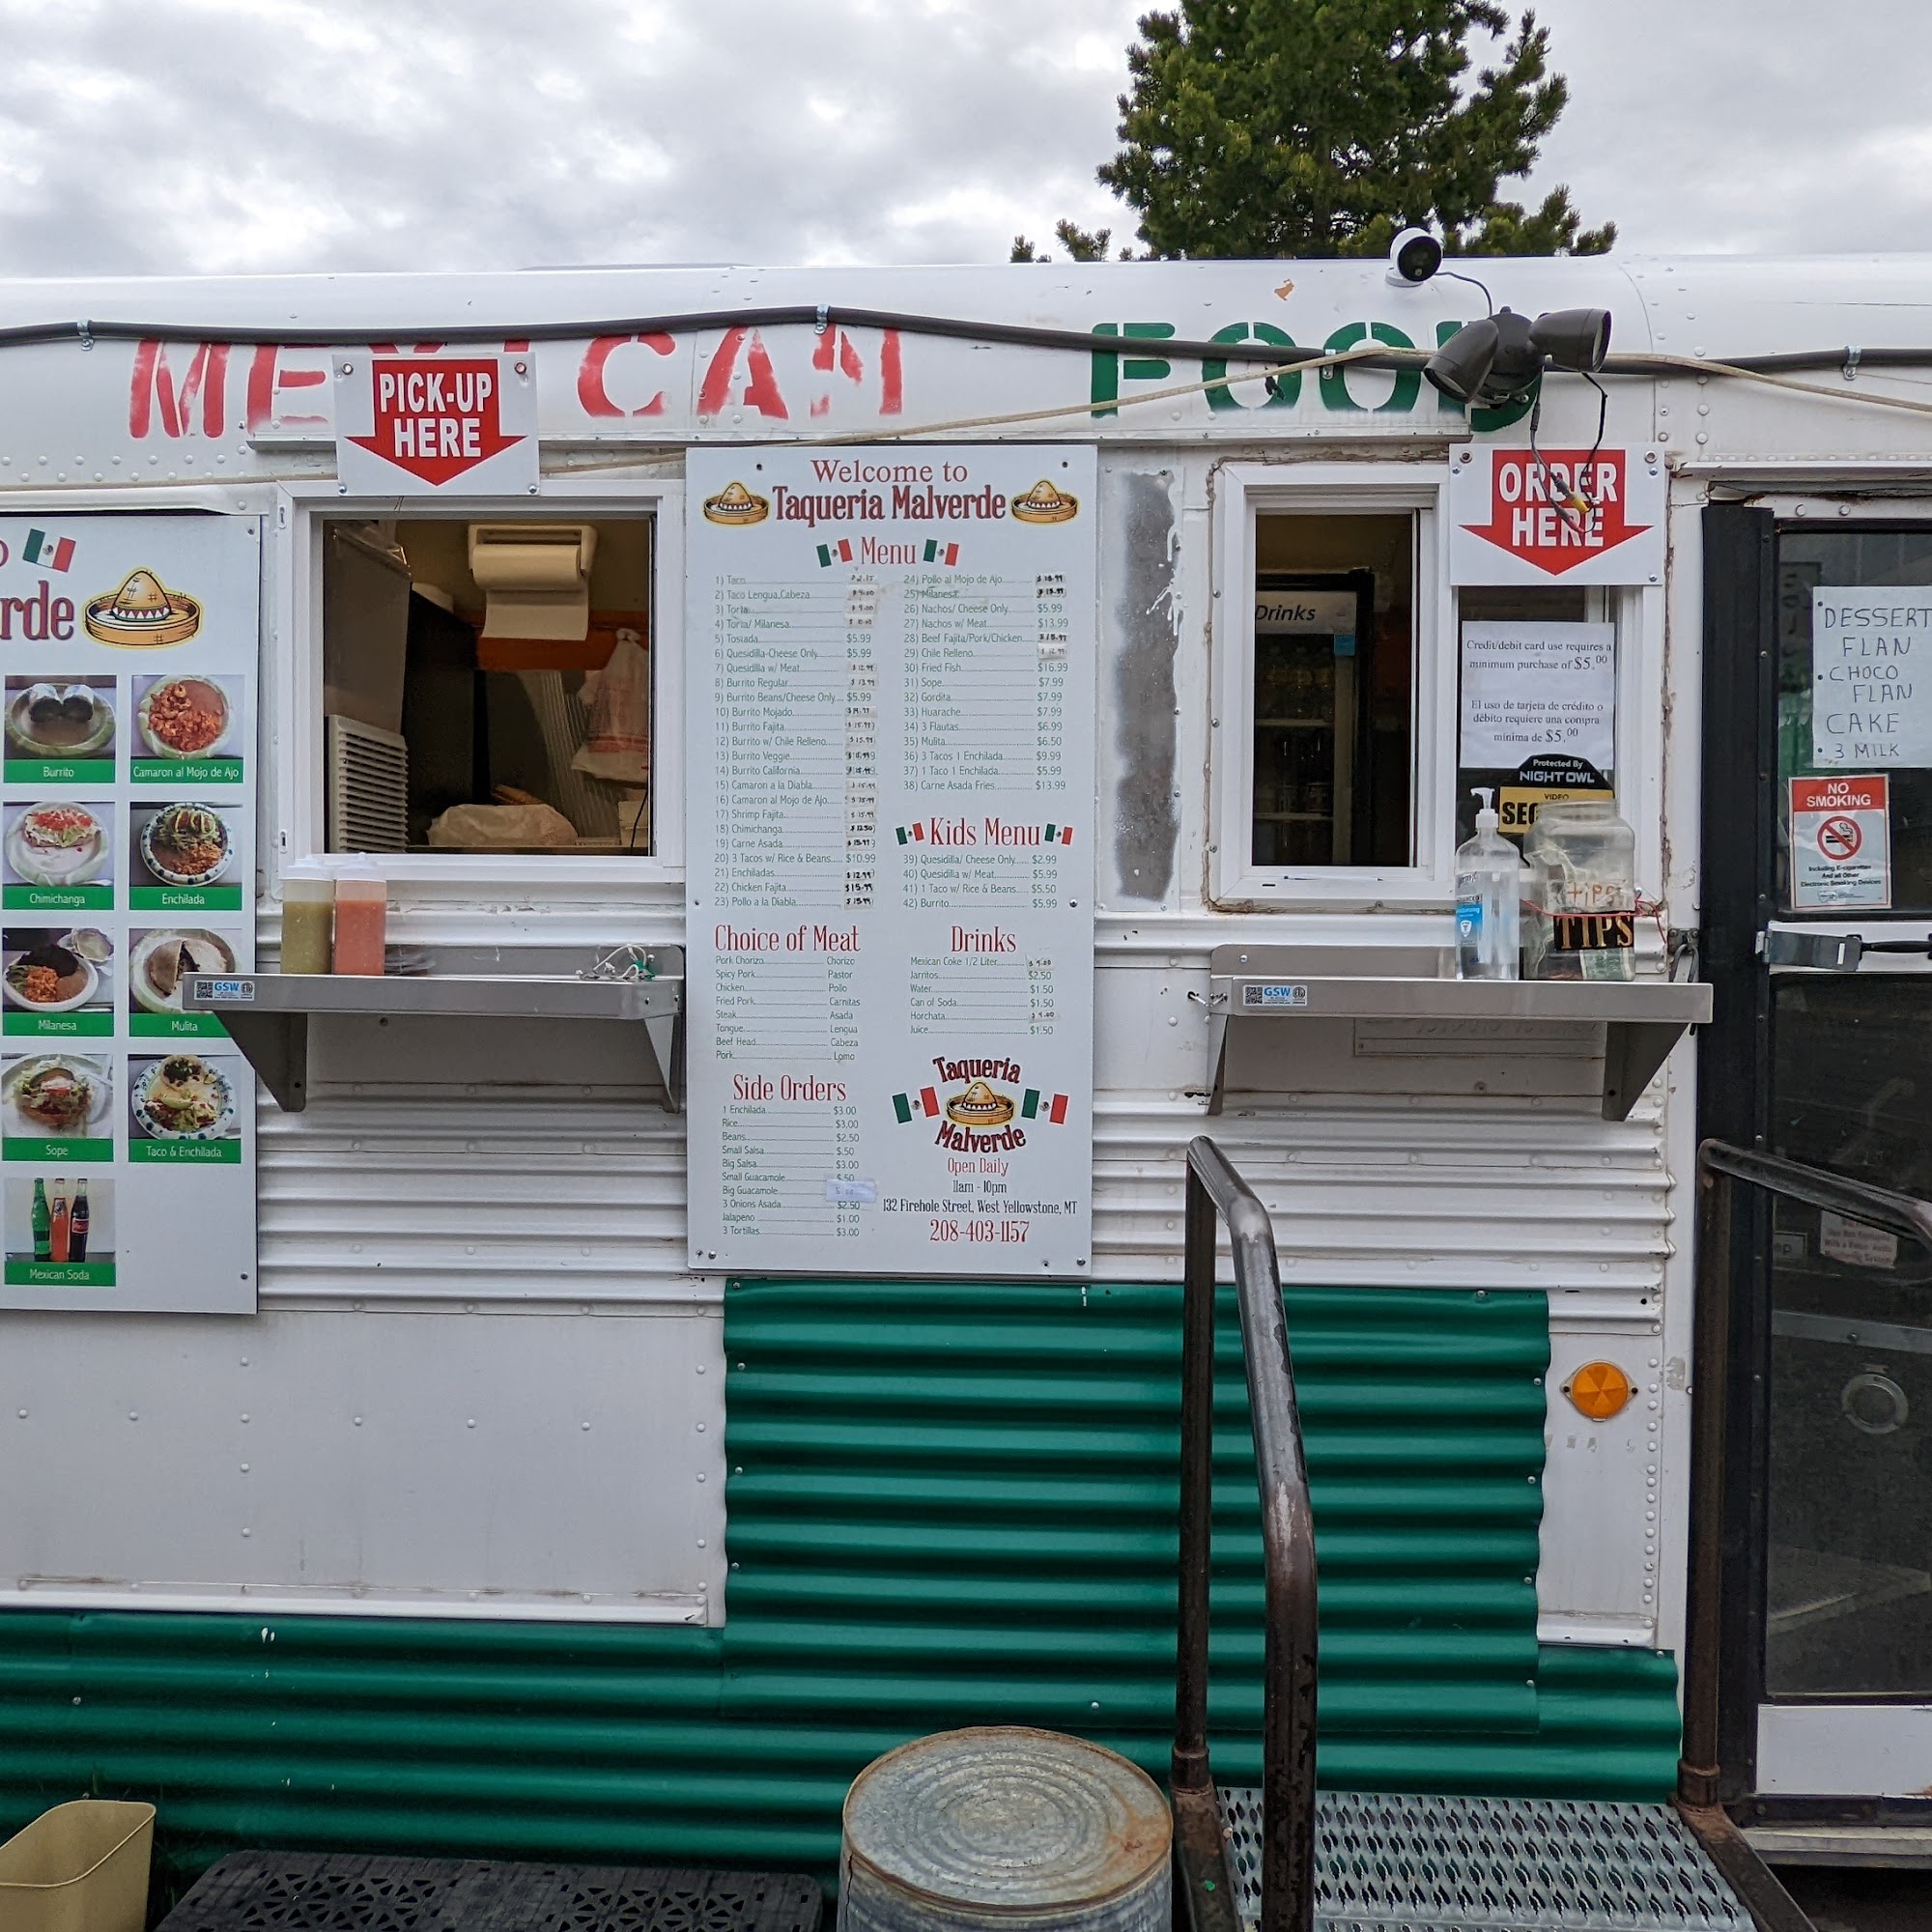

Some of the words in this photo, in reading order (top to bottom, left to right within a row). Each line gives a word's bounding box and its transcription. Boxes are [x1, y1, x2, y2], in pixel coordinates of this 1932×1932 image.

[128, 325, 903, 440] MECAN
[381, 373, 492, 412] PICK-UP
[394, 418, 481, 458] HERE
[810, 460, 934, 482] Welcome
[943, 461, 968, 482] to
[1499, 463, 1617, 501] ORDER
[773, 485, 885, 527] Taqueria
[892, 485, 1006, 521] Malverde
[1513, 508, 1603, 546] HERE
[861, 536, 916, 564] Menu
[1256, 605, 1316, 621] Drinks
[922, 619, 952, 628] Nachos
[954, 619, 963, 628] w/
[967, 619, 987, 628] Meat
[1037, 618, 1068, 628] $13.99
[1466, 640, 1521, 651] Credit/debit
[1525, 641, 1545, 651] card
[1548, 642, 1563, 651] use
[1566, 642, 1603, 653] requires
[1842, 637, 1911, 657] FLAN
[1469, 660, 1515, 669] minimum
[1518, 661, 1558, 670] purchase
[1562, 661, 1573, 669] of
[1830, 665, 1898, 681] CHOCO
[847, 693, 871, 702] $5.99
[1854, 683, 1913, 703] FLAN
[922, 707, 960, 716] Huarache
[1037, 707, 1062, 717] $7.99
[1471, 700, 1481, 709] El
[1503, 700, 1514, 710] de
[1518, 701, 1545, 712] tarjeta
[1548, 701, 1559, 711] de
[1505, 715, 1543, 725] requiere
[1565, 717, 1599, 726] compra
[1827, 712, 1900, 734] CAKE
[1531, 733, 1543, 743] de
[1834, 743, 1844, 759] 3
[1855, 743, 1900, 759] MILK
[1533, 758, 1572, 768] Protected
[1573, 760, 1583, 769] By
[43, 767, 74, 779] Burrito
[133, 767, 173, 779] Camaron
[177, 766, 185, 778] al
[186, 766, 208, 780] Mojo
[211, 767, 222, 778] de
[224, 767, 239, 780] Ajo
[1520, 771, 1565, 782] NIGHT
[1566, 773, 1594, 782] OWL
[904, 781, 918, 790] 38)
[1036, 781, 1065, 790] $13.99
[1828, 782, 1850, 794] NO
[1806, 794, 1871, 808] SMOKING
[930, 817, 977, 845] Kids
[985, 817, 1039, 845] Menu
[765, 854, 775, 863] w/
[778, 854, 794, 863] Rice
[807, 854, 831, 863] Beans
[846, 854, 876, 864] $10.99
[29, 894, 85, 906] Chimichanga
[162, 894, 205, 905] Enchilada
[921, 898, 949, 908] Burrito
[1032, 898, 1057, 908] $5.99
[715, 924, 779, 952] Choice
[786, 925, 807, 952] of
[813, 925, 861, 952] Meat
[1556, 914, 1634, 950] TIPS
[952, 925, 1016, 952] Drinks
[716, 970, 735, 980] Spicy
[828, 970, 852, 979] Pastor
[214, 982, 239, 991] GSW
[829, 983, 847, 992] Pollo
[910, 984, 932, 993] Water
[1030, 985, 1053, 994] $1.50
[1264, 987, 1291, 996] GSW
[830, 997, 861, 1006] Carnitas
[911, 998, 924, 1007] Can
[927, 998, 934, 1007] of
[938, 998, 957, 1007] Soda
[1030, 999, 1054, 1009] $1.50
[39, 1020, 76, 1031] Milanesa
[171, 1020, 198, 1032] Mulita
[831, 1037, 858, 1046] Cabeza
[933, 1056, 1021, 1083] Taqueria
[733, 1074, 773, 1100] Side
[781, 1074, 846, 1101] Orders
[836, 1120, 858, 1128] $3.00
[837, 1133, 859, 1142] $2.50
[934, 1121, 1026, 1152] Malverde
[46, 1145, 69, 1157] Sope
[147, 1145, 166, 1157] Taco
[170, 1146, 177, 1157] &
[180, 1146, 222, 1157] Enchilada
[948, 1157, 975, 1176] Open
[980, 1158, 1009, 1177] Daily
[953, 1180, 974, 1193] 11am
[983, 1180, 1007, 1196] 10pm
[883, 1199, 897, 1211] 132
[900, 1199, 939, 1212] Firehole
[942, 1199, 974, 1214] Street,
[978, 1200, 1000, 1213] West
[1003, 1200, 1062, 1215] Yellowstone,
[1065, 1201, 1077, 1214] MT
[723, 1226, 727, 1235] 3
[730, 1226, 760, 1235] Tortillas
[837, 1228, 859, 1236] $3.00
[930, 1219, 1029, 1242] 208-403-1157
[30, 1268, 65, 1280] Mexican
[68, 1269, 90, 1280] Soda
